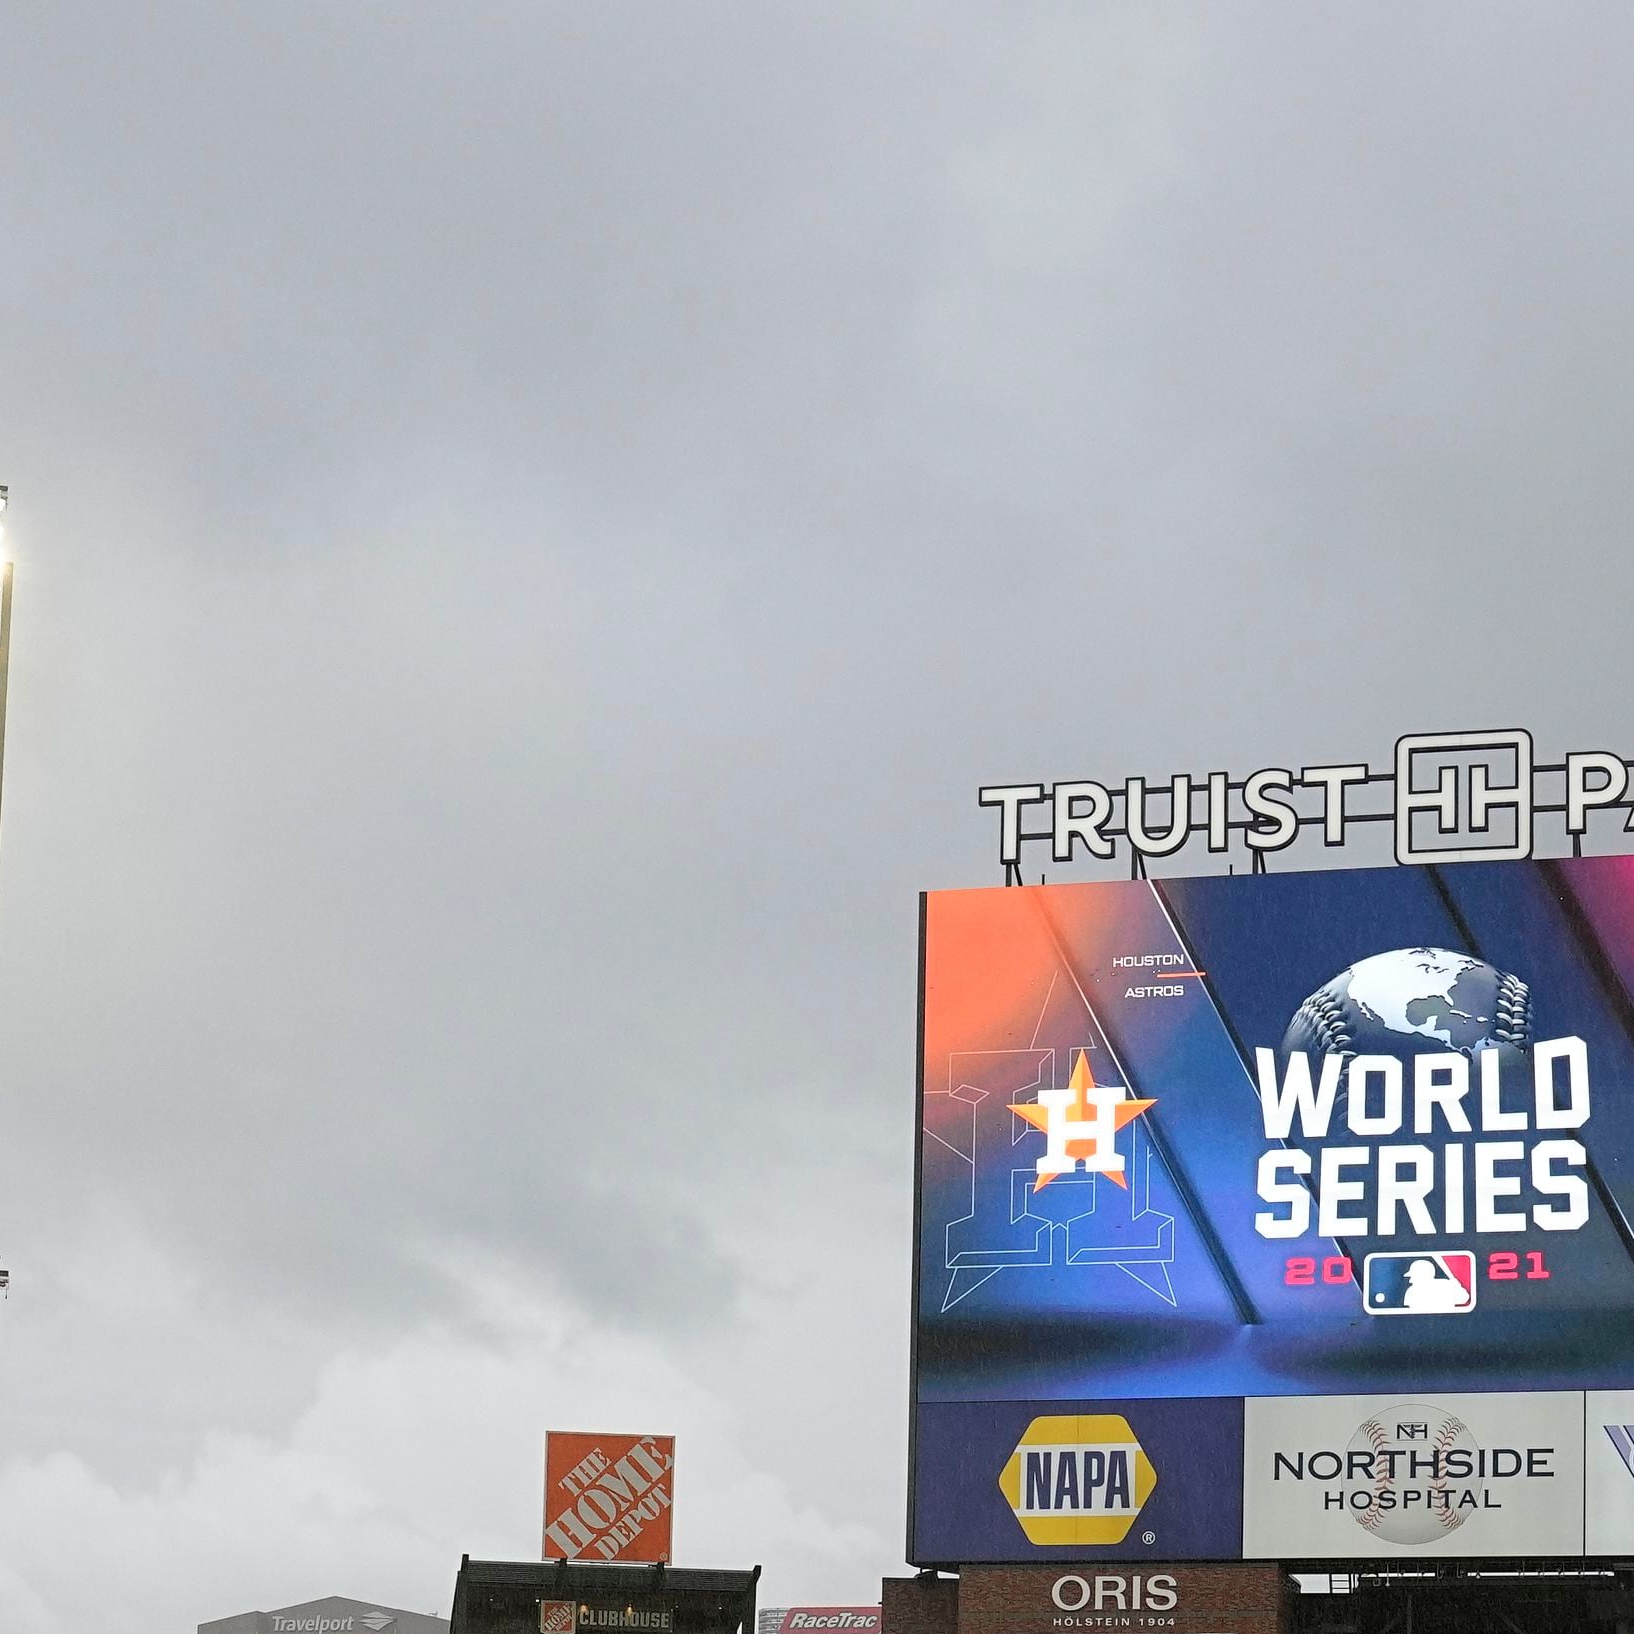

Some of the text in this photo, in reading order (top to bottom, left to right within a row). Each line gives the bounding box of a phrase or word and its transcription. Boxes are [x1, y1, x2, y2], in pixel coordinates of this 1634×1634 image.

[979, 762, 1368, 865] TRUIST
[1112, 954, 1185, 968] HOUSTON
[1124, 985, 1184, 998] ASTROS
[1254, 1035, 1591, 1140] WORLD
[1036, 1086, 1127, 1174] H
[1253, 1138, 1590, 1240] SERIES
[1284, 1251, 1551, 1286] 20 21
[558, 1447, 612, 1497] THE
[1025, 1449, 1126, 1510] NAPA
[1273, 1447, 1555, 1482] NORTHSIDE
[545, 1436, 673, 1560] HOME
[1323, 1488, 1502, 1511] HOSPITAL
[595, 1483, 671, 1560] DEPOT
[1051, 1574, 1179, 1611] ORIS
[579, 1610, 670, 1629] CLUBHOUSE
[789, 1612, 878, 1629] RaceTrac
[1053, 1615, 1176, 1627] HÖLSTEIN 1904
